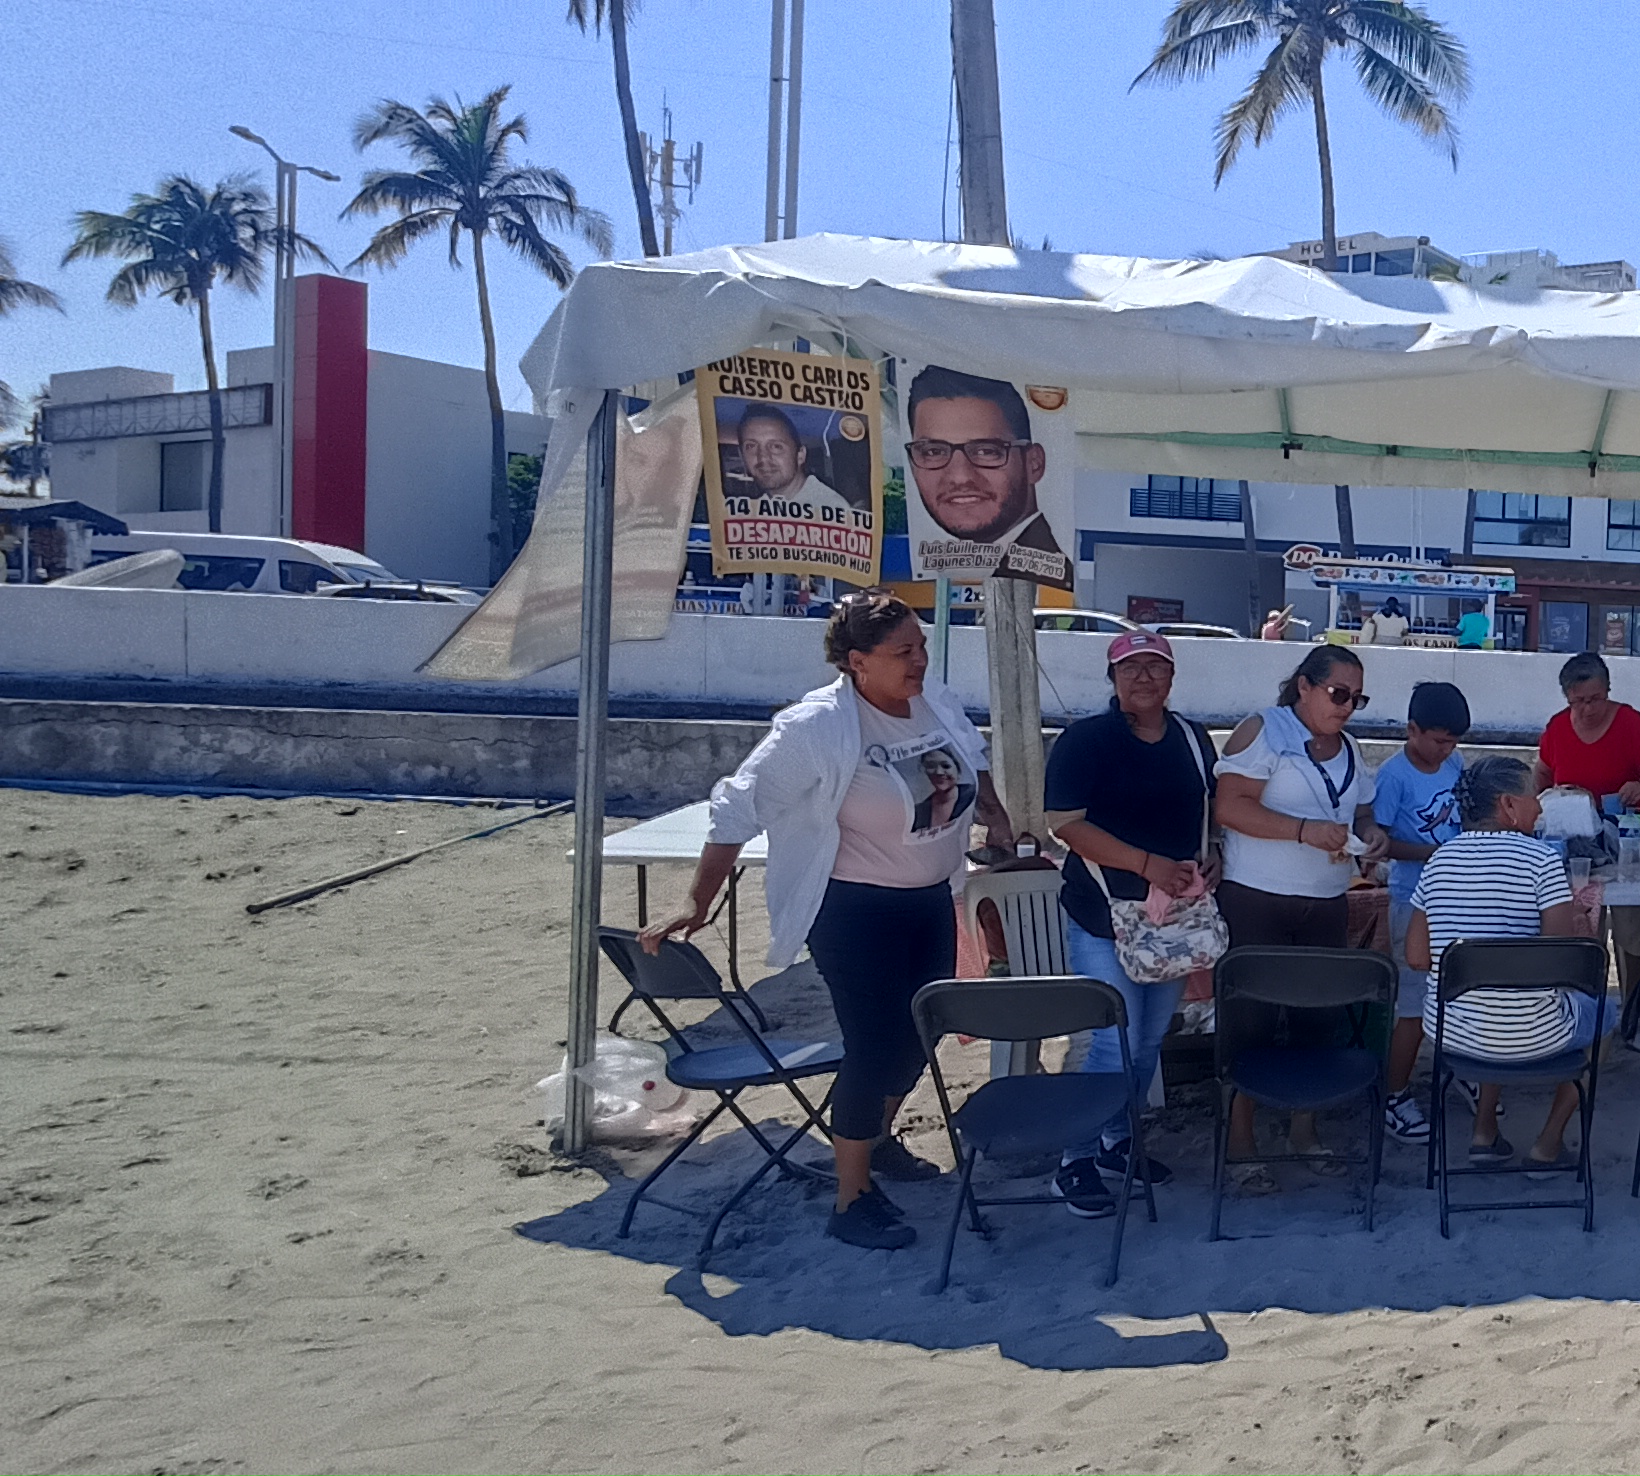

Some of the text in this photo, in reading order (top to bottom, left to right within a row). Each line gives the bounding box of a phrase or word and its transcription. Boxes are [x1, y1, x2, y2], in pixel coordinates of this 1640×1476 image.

[1301, 240, 1357, 255] HOEL
[707, 355, 870, 391] ROBERTO CARLOS
[719, 375, 864, 411] CASSO CASTRO
[725, 496, 873, 530] 14 AÑOS DE TU
[727, 522, 871, 556] DESAPARICIÓN
[946, 542, 1001, 555] Guillermo
[728, 547, 871, 574] TE SIGO BUSCANDO HIJO
[925, 556, 972, 569] Lagunes
[1291, 550, 1316, 564] DQ
